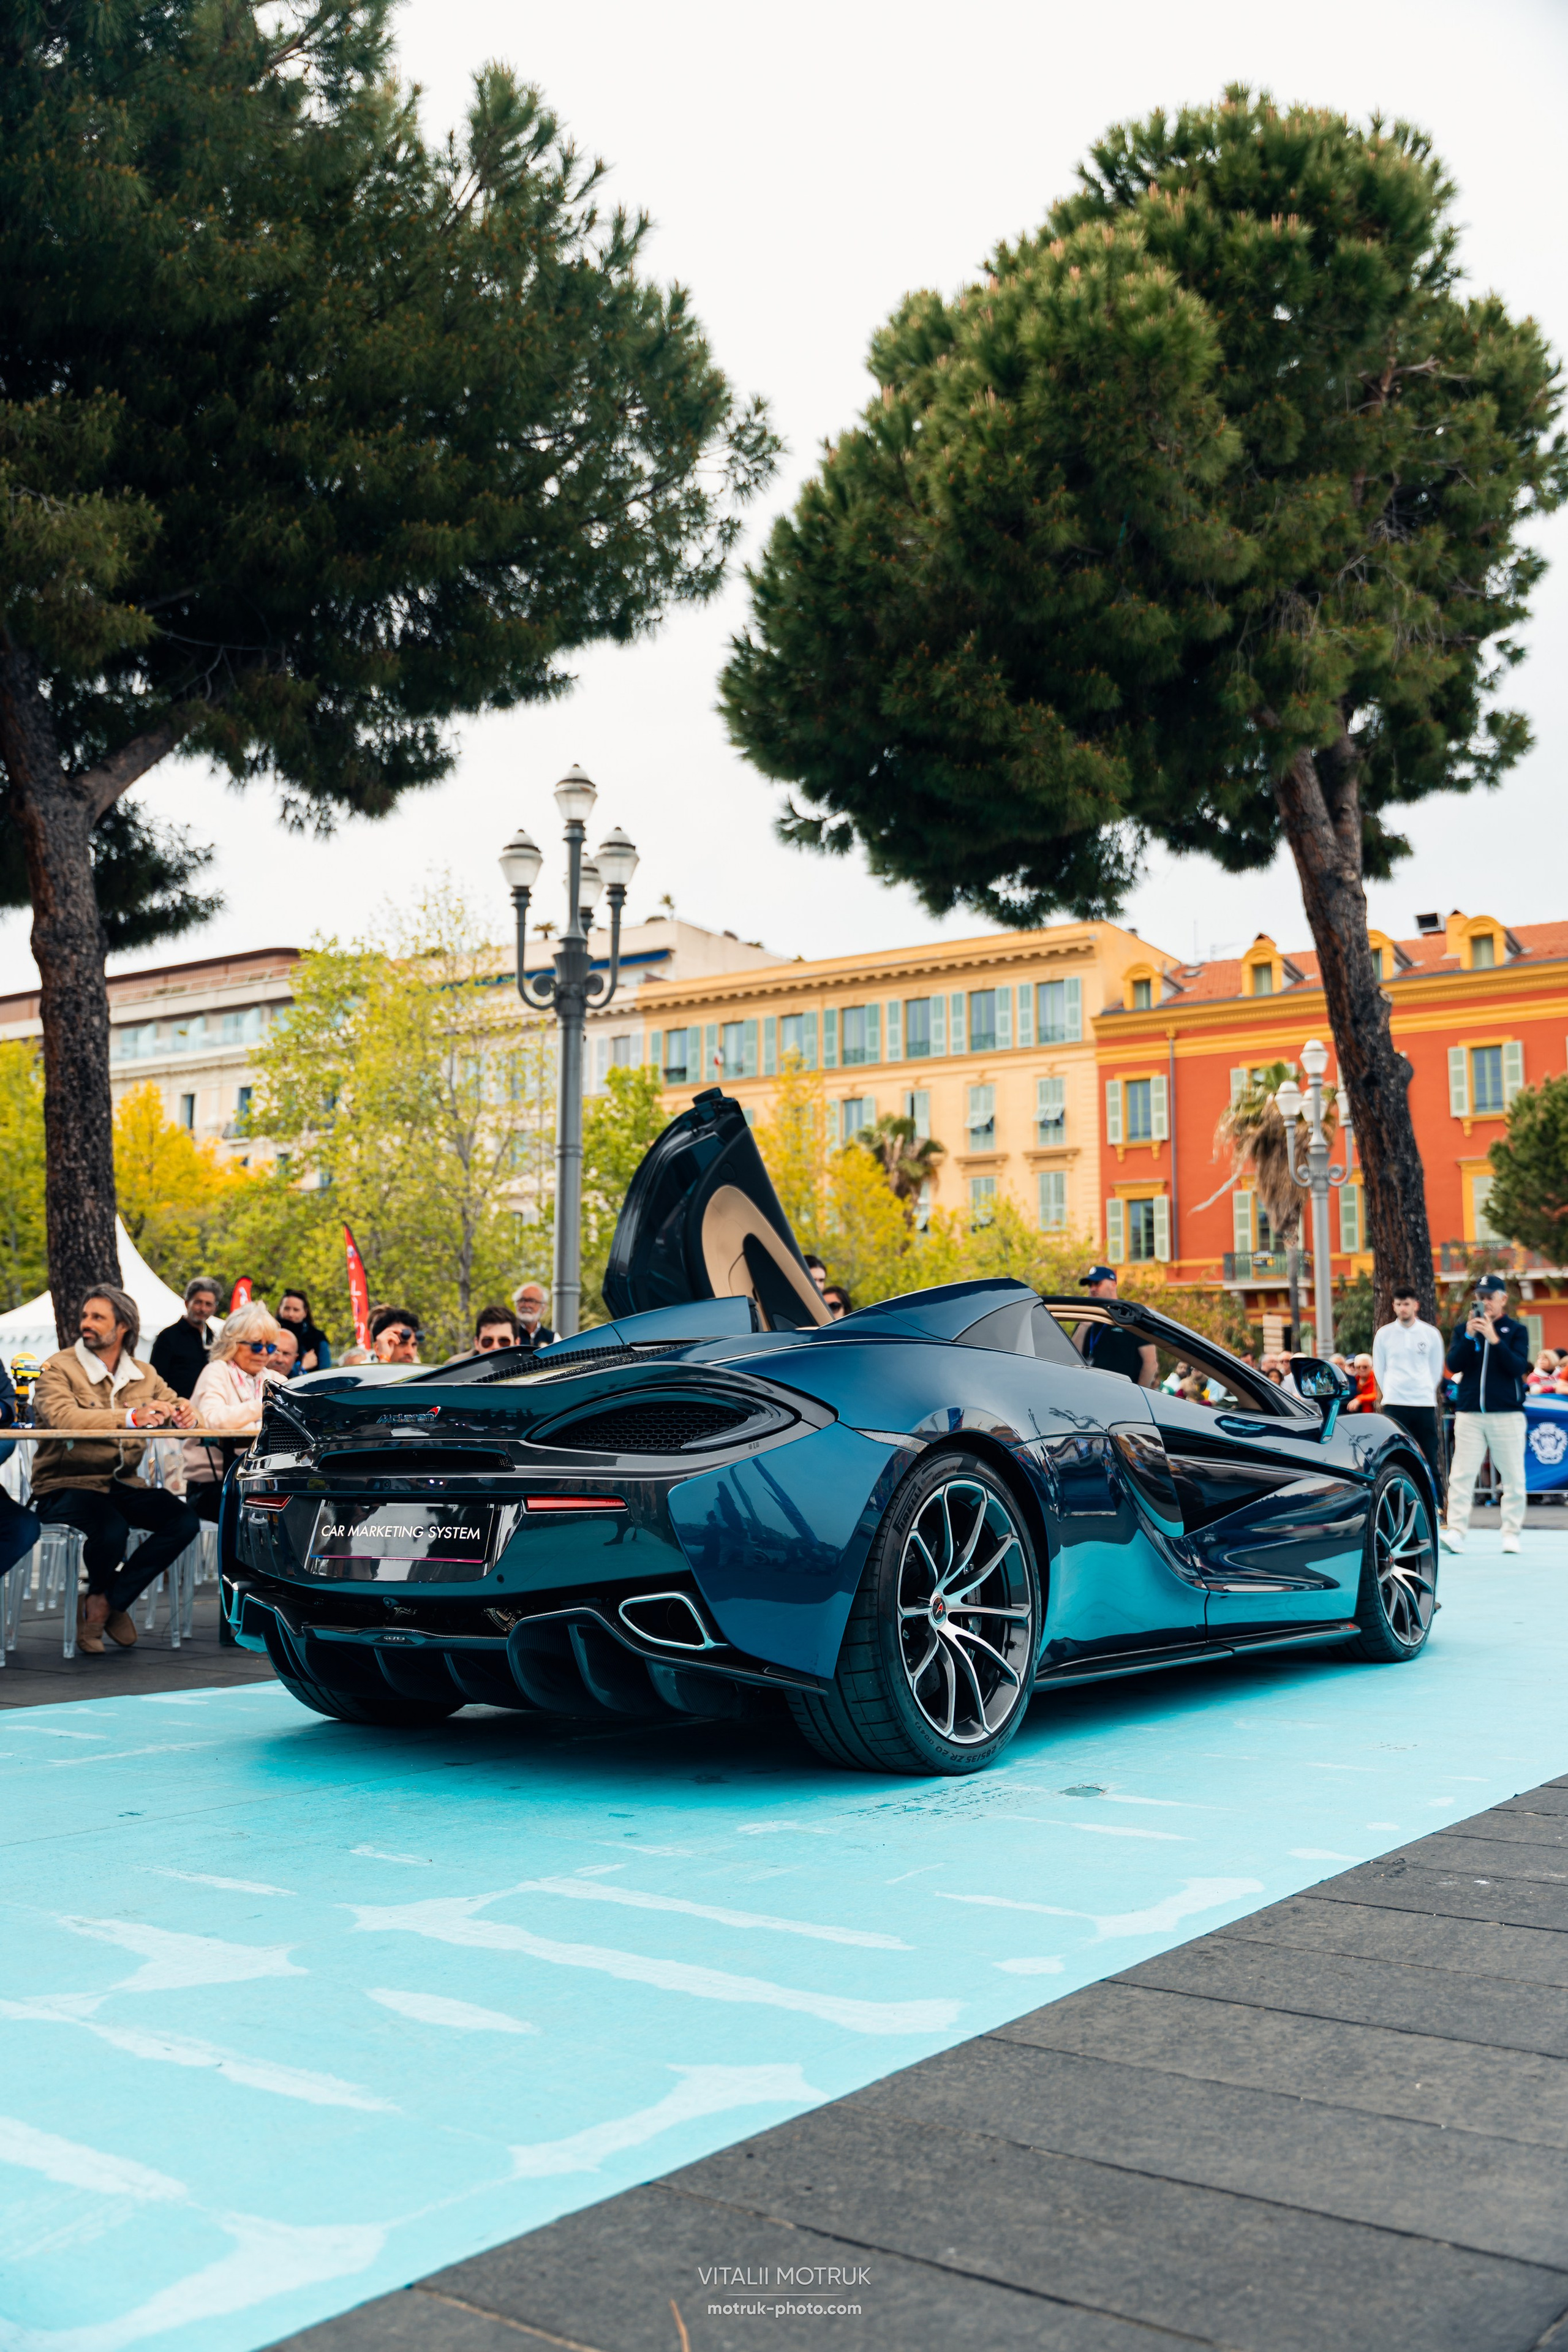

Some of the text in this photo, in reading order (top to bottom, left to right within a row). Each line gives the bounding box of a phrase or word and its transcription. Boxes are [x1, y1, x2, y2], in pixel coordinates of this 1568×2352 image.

[376, 1414, 434, 1423] McLaren
[892, 1482, 923, 1537] PIRELLI
[321, 1525, 481, 1540] CAR MARKETING SYSTEM
[935, 1746, 949, 1757] 20
[950, 1753, 965, 1763] ZR
[965, 1744, 997, 1763] 285/35
